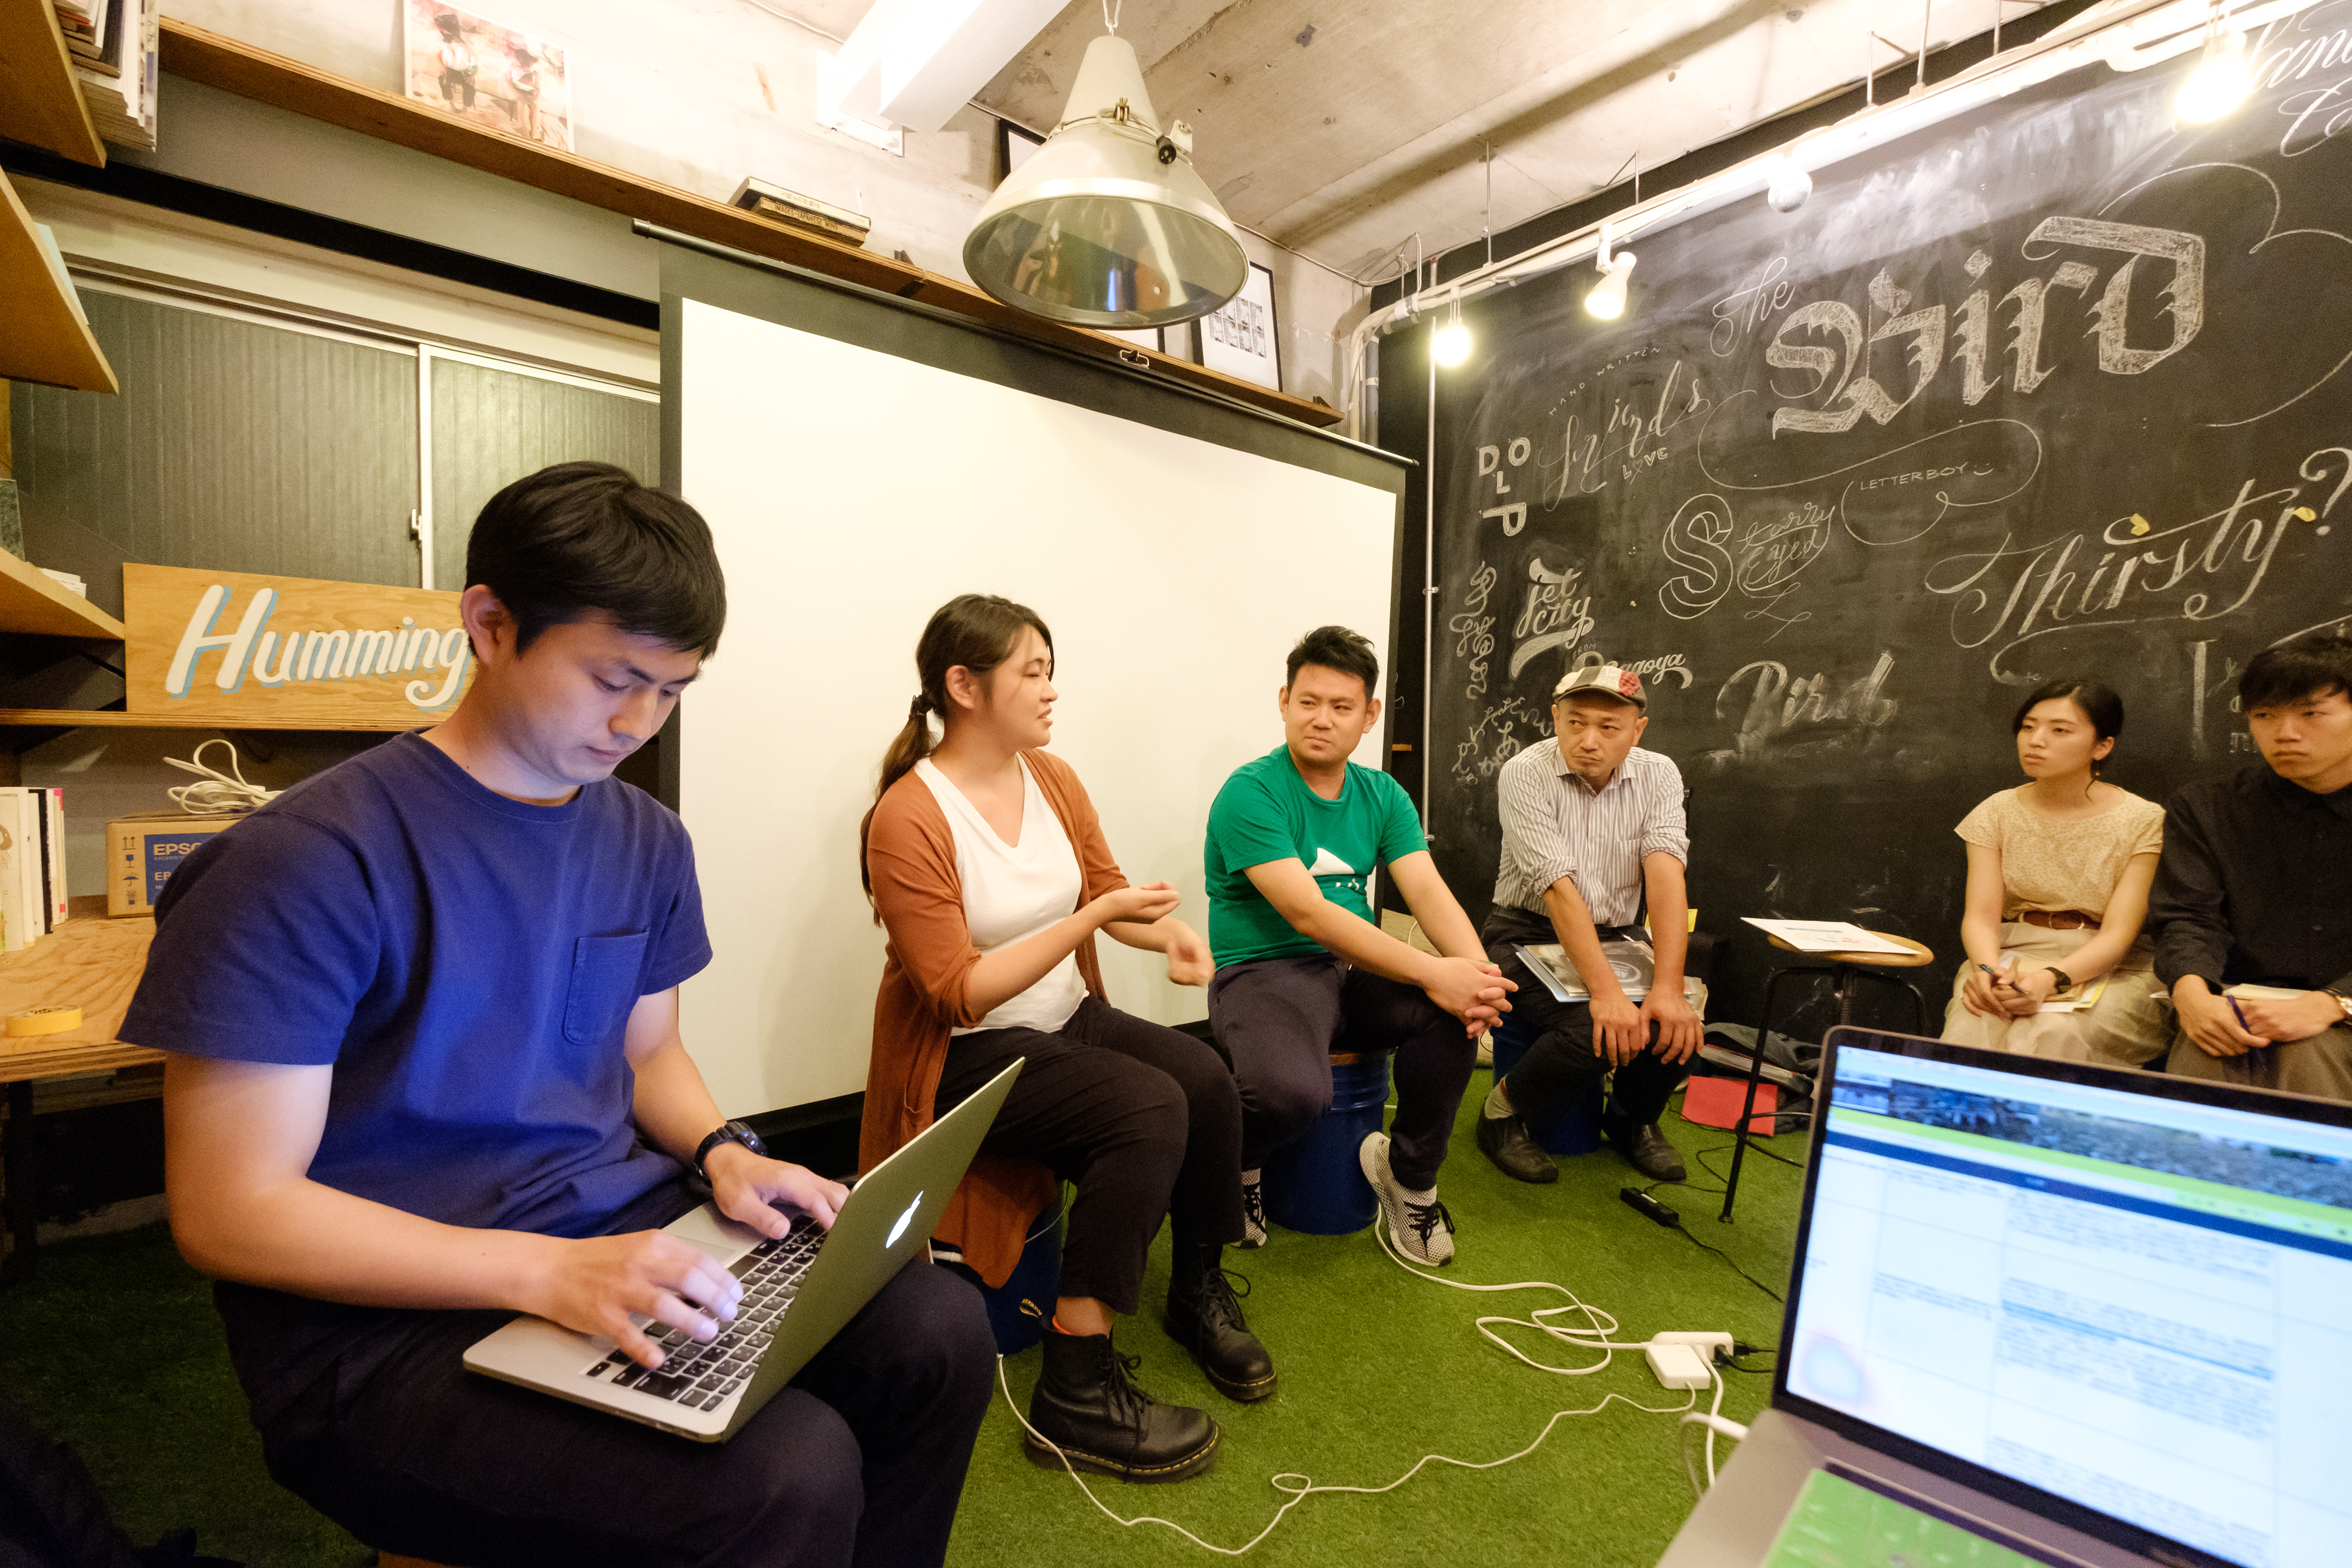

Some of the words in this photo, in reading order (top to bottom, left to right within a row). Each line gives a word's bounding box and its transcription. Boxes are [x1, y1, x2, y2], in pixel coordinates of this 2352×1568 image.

[825, 221, 838, 230] MIND
[1710, 256, 1796, 357] The
[1860, 462, 1968, 490] LETTERBOY
[1925, 447, 2352, 648] Thirsty?
[166, 584, 472, 710] Humming
[1572, 643, 1596, 660] FROM
